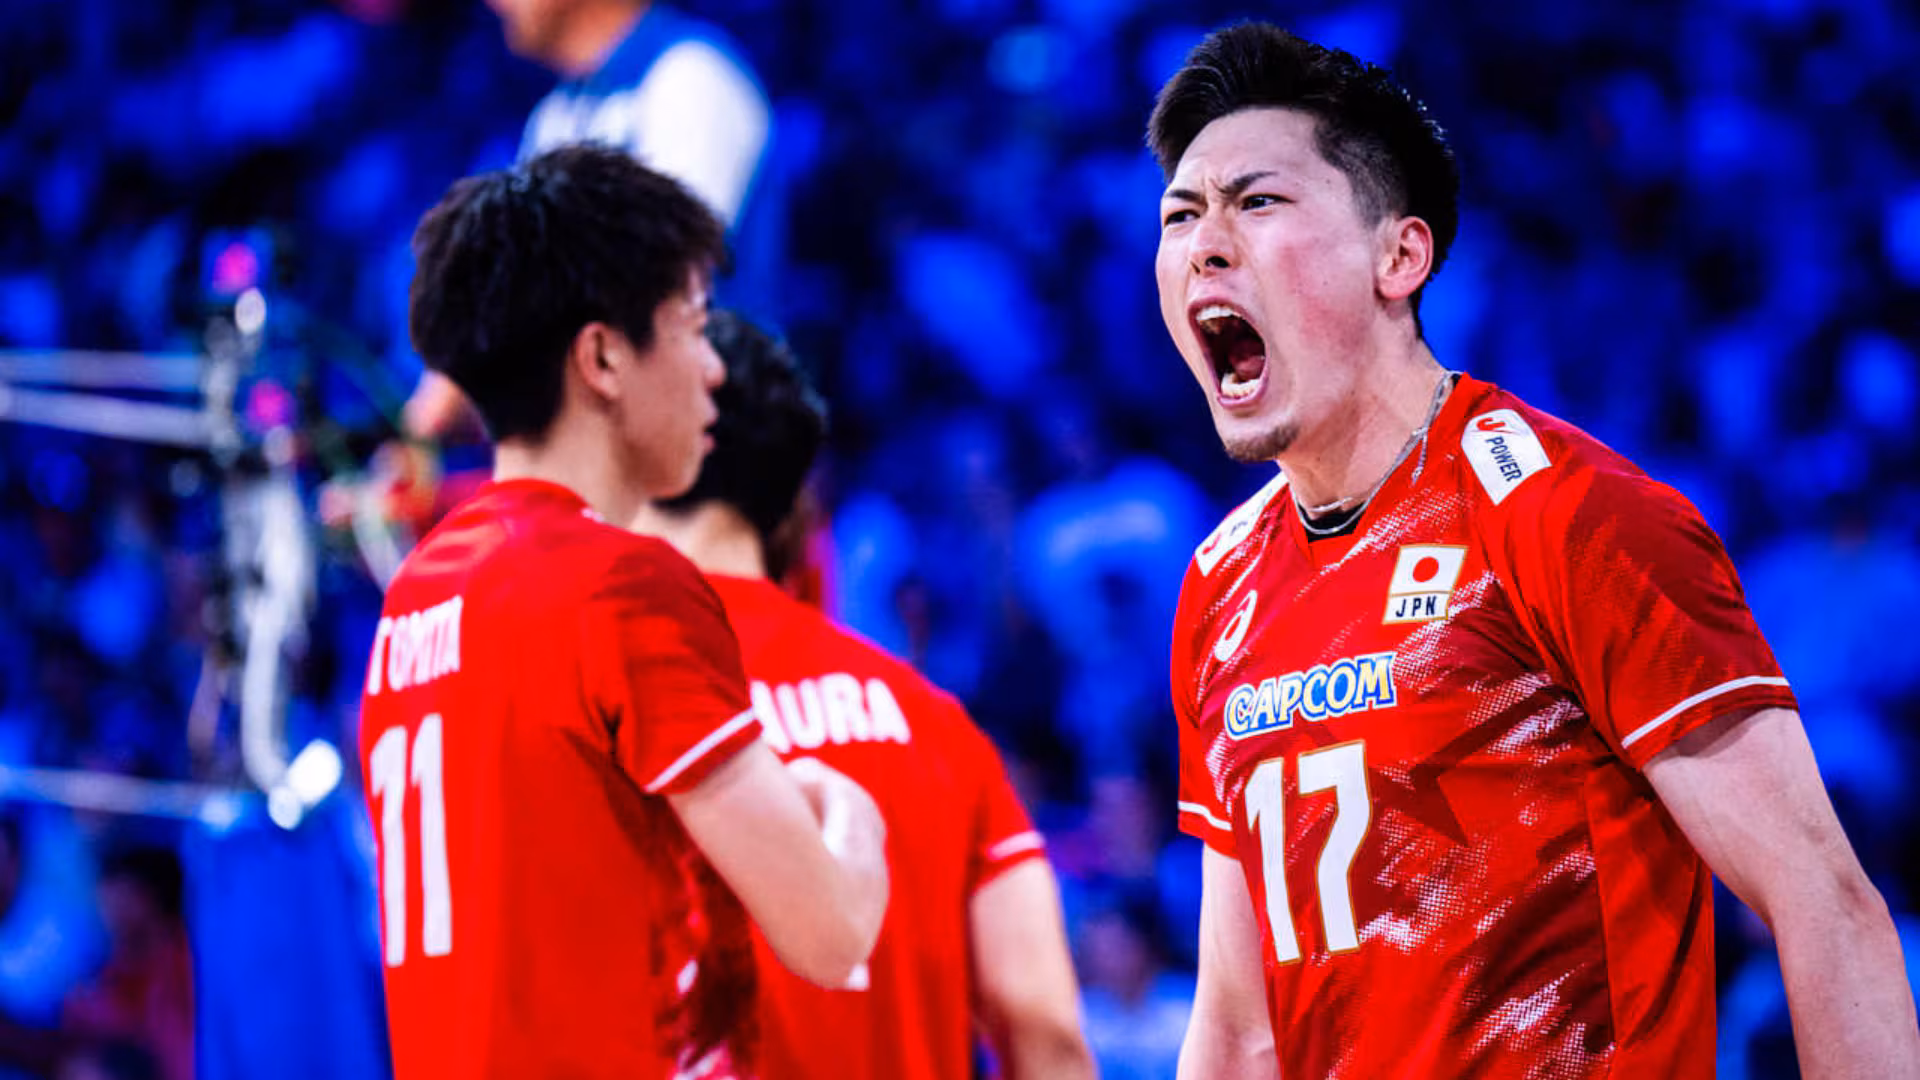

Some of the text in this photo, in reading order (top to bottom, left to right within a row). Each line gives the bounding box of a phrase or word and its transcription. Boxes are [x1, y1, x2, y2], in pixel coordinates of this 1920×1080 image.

[1484, 435, 1522, 482] POWER
[1395, 595, 1437, 617] JPN
[1225, 652, 1396, 739] CAPCOM
[370, 713, 452, 967] 11
[1244, 739, 1372, 965] 17
